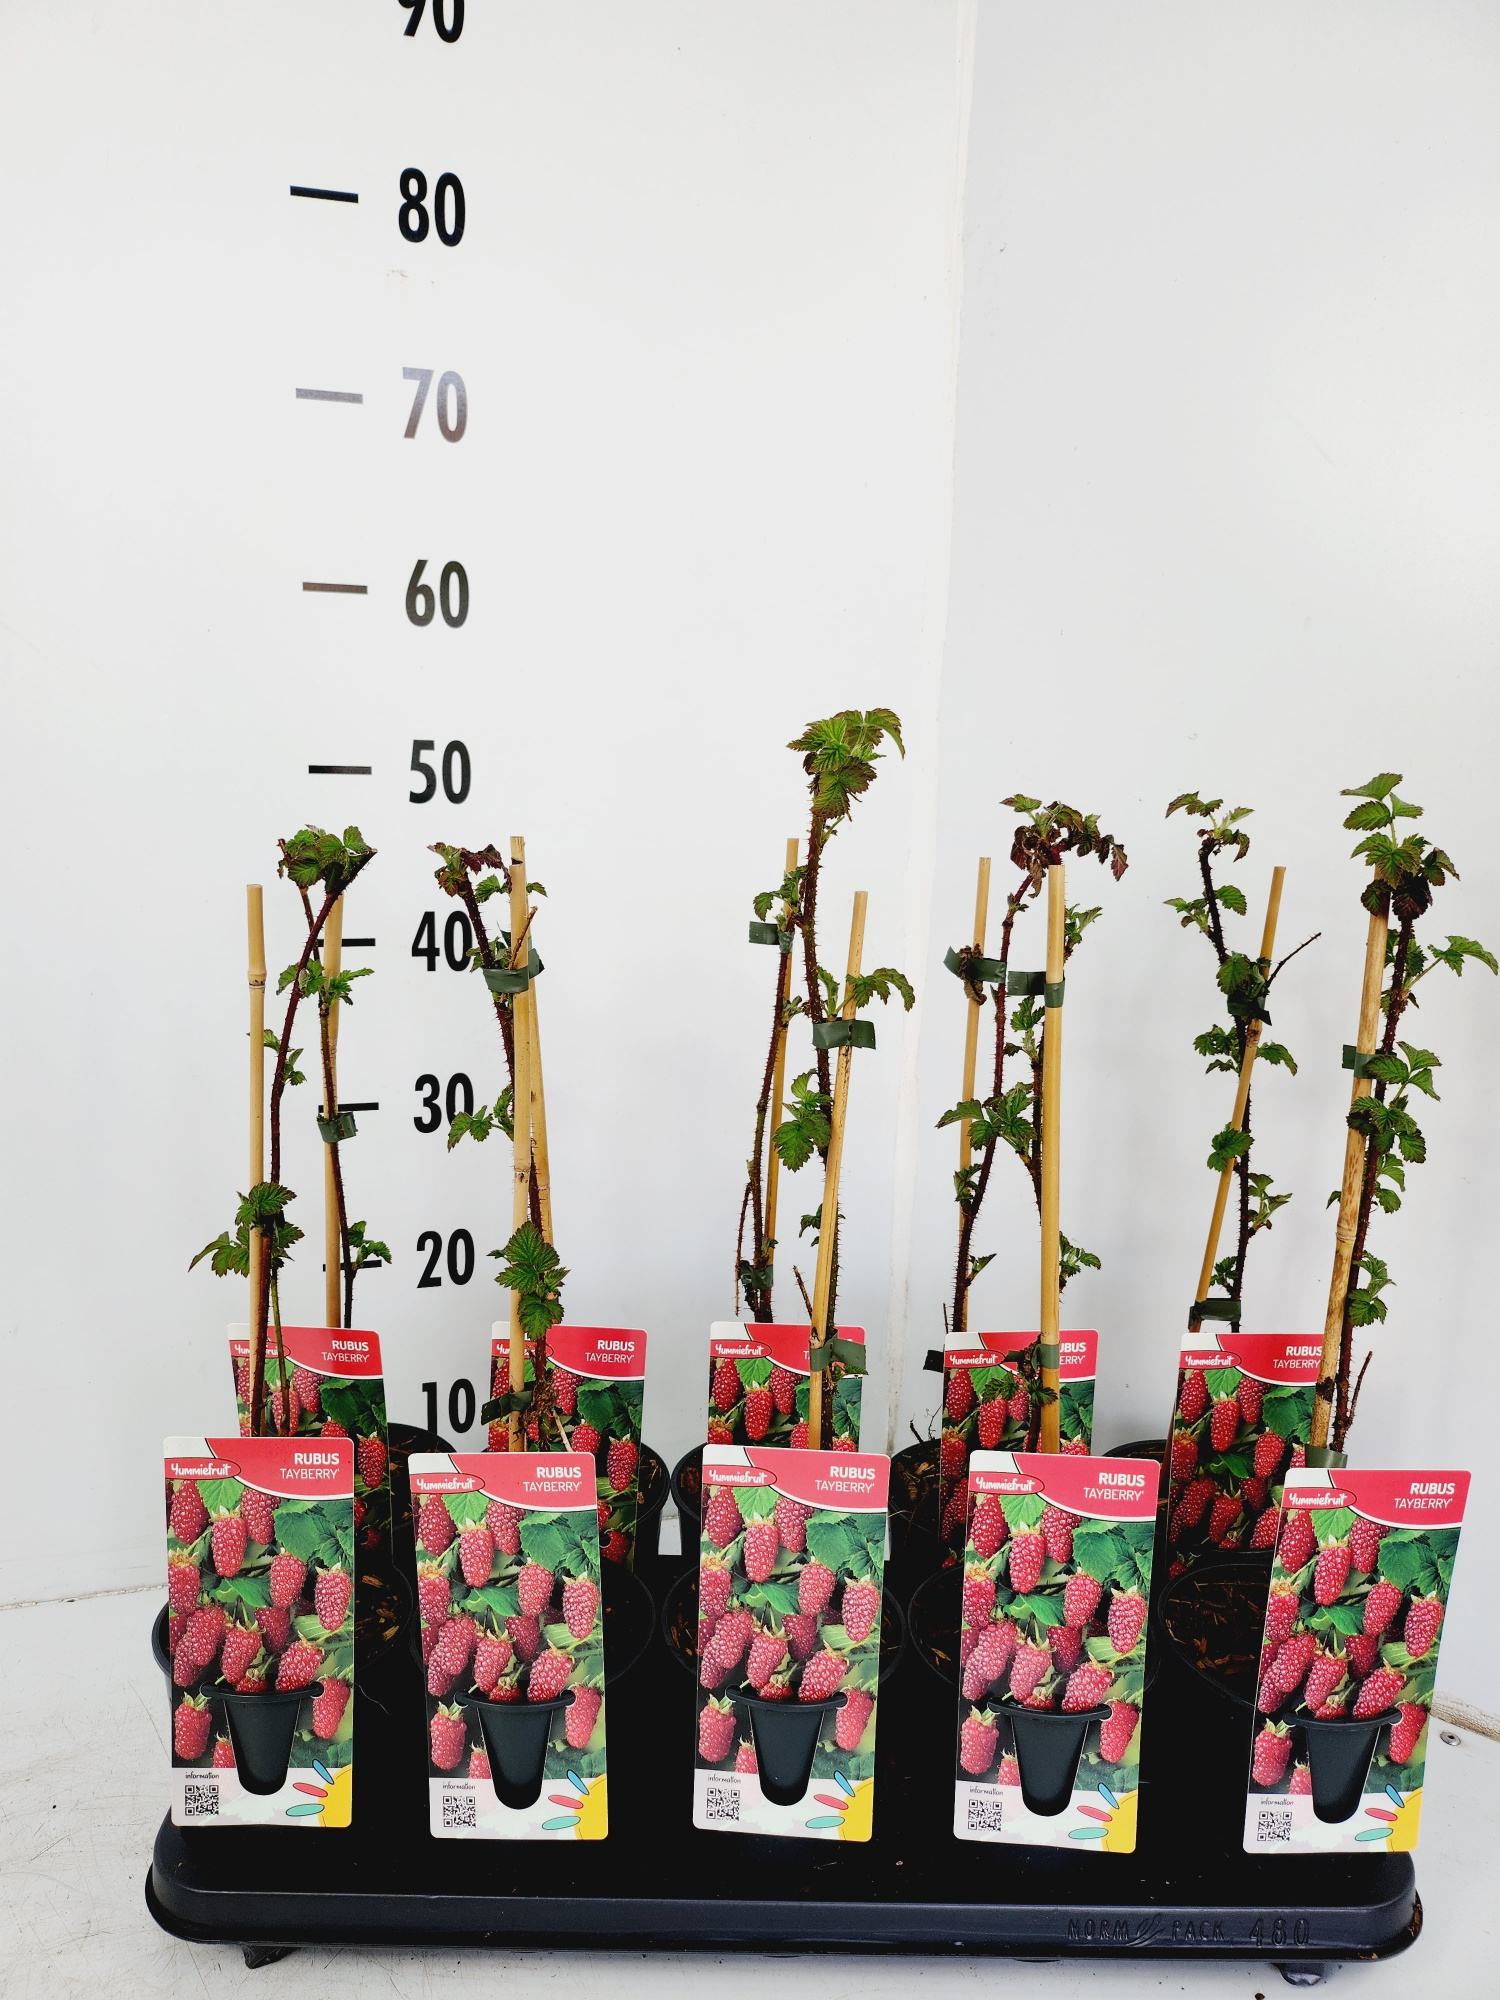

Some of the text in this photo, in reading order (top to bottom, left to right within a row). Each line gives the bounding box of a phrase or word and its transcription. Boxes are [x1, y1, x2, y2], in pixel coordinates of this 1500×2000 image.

[398, 168, 466, 247] 80
[402, 367, 468, 444] 70
[405, 558, 470, 629] 60
[409, 739, 472, 805] 50
[412, 910, 473, 973] 40
[414, 1073, 475, 1134] 30
[416, 1227, 476, 1289] 20
[331, 1340, 370, 1352] RUBUS
[596, 1339, 635, 1352] RUBUS
[714, 1343, 765, 1357] Yummiefruit
[1059, 1342, 1087, 1353] UBUS
[1285, 1345, 1323, 1358] RUBUS
[949, 1354, 999, 1366] Yummiefruit
[1184, 1354, 1235, 1367] Yummiefruit
[1272, 1359, 1321, 1369] TAYBERRY
[422, 1378, 476, 1437] 10
[294, 1452, 340, 1465] RUBUS
[170, 1462, 232, 1477] Yummiefruit
[536, 1466, 582, 1479] RUBUS
[708, 1468, 768, 1485] Yummiefruit
[829, 1466, 876, 1480] RUBUS
[416, 1477, 476, 1491] Yummiefruit
[975, 1476, 1036, 1492] Yummiefruit
[1098, 1472, 1146, 1487] RUBUS
[1409, 1482, 1456, 1495] RUBUS
[1288, 1492, 1348, 1506] Yummiefruit
[185, 1771, 220, 1780] information
[707, 1774, 742, 1785] information
[442, 1781, 476, 1791] information
[969, 1786, 1004, 1796] information
[1260, 1798, 1294, 1807] information
[1068, 1917, 1310, 1947] NORM PACK 480
